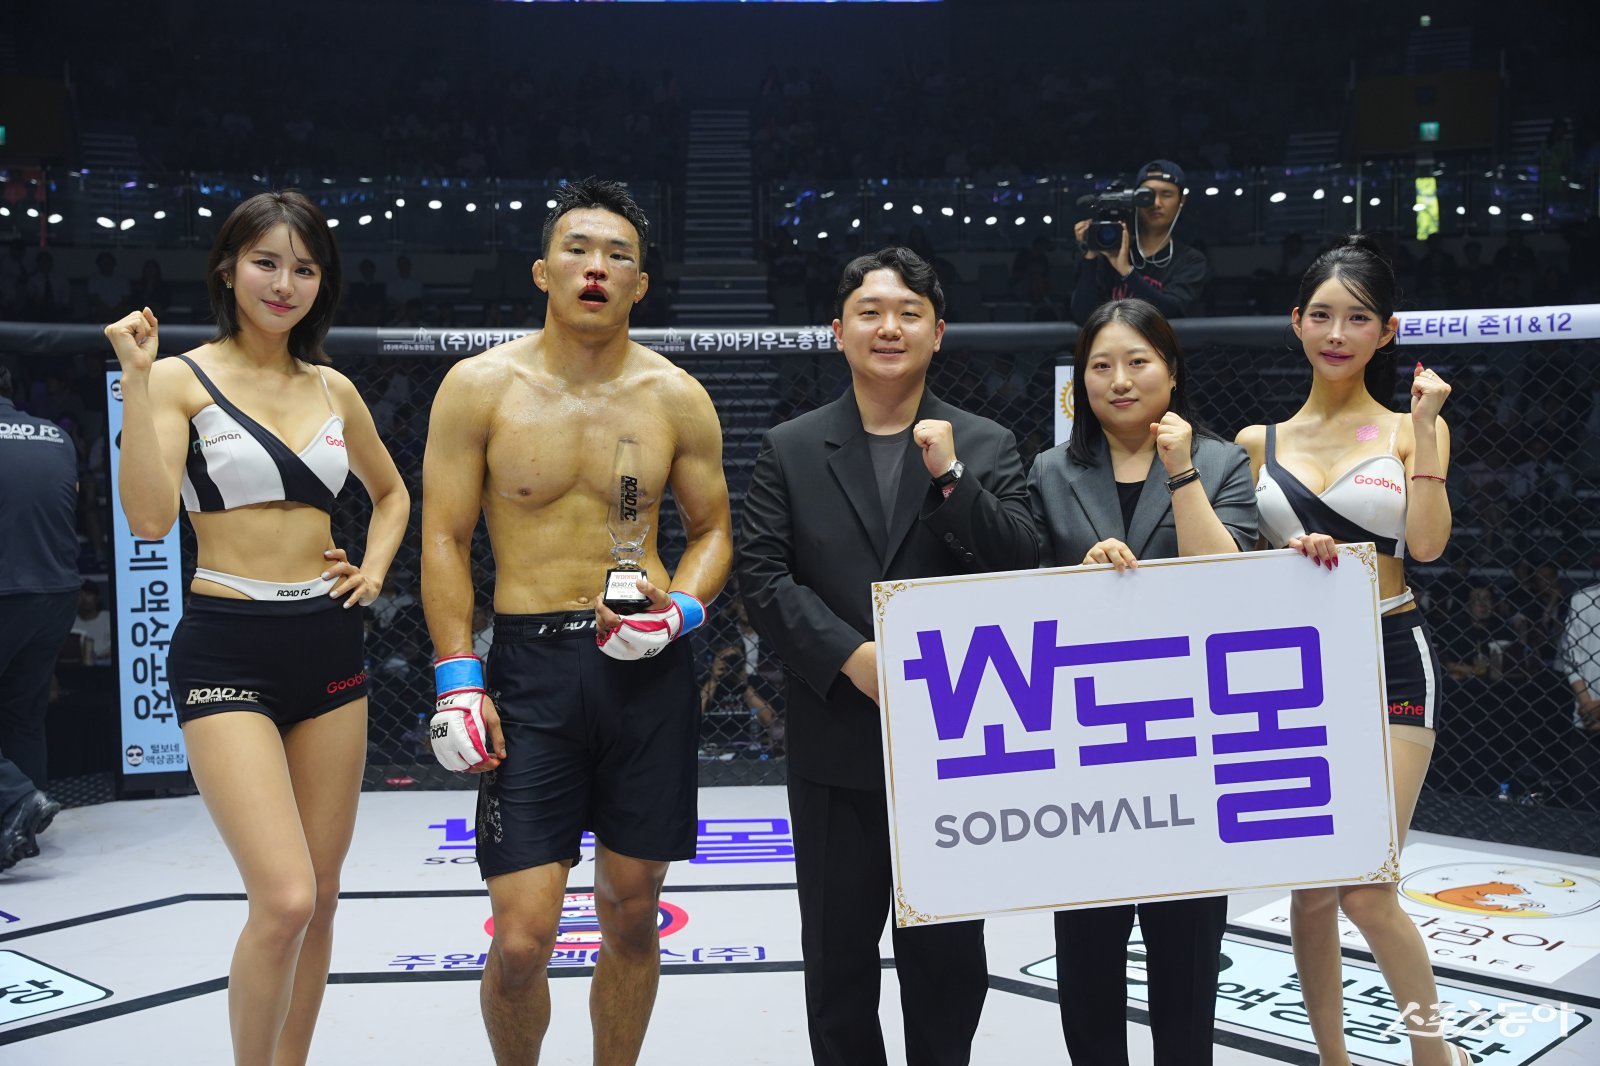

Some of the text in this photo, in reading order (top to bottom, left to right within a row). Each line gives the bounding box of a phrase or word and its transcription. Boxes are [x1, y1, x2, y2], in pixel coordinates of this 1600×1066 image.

[690, 330, 836, 351] (주)아키우노종합
[0, 422, 60, 438] OAD FC
[625, 475, 637, 506] ROAD
[276, 589, 300, 597] ROAD
[188, 687, 236, 700] ROAD
[145, 753, 185, 765] 액상공장
[934, 793, 1196, 849] SODOMALL
[1434, 948, 1536, 972] CAFE
